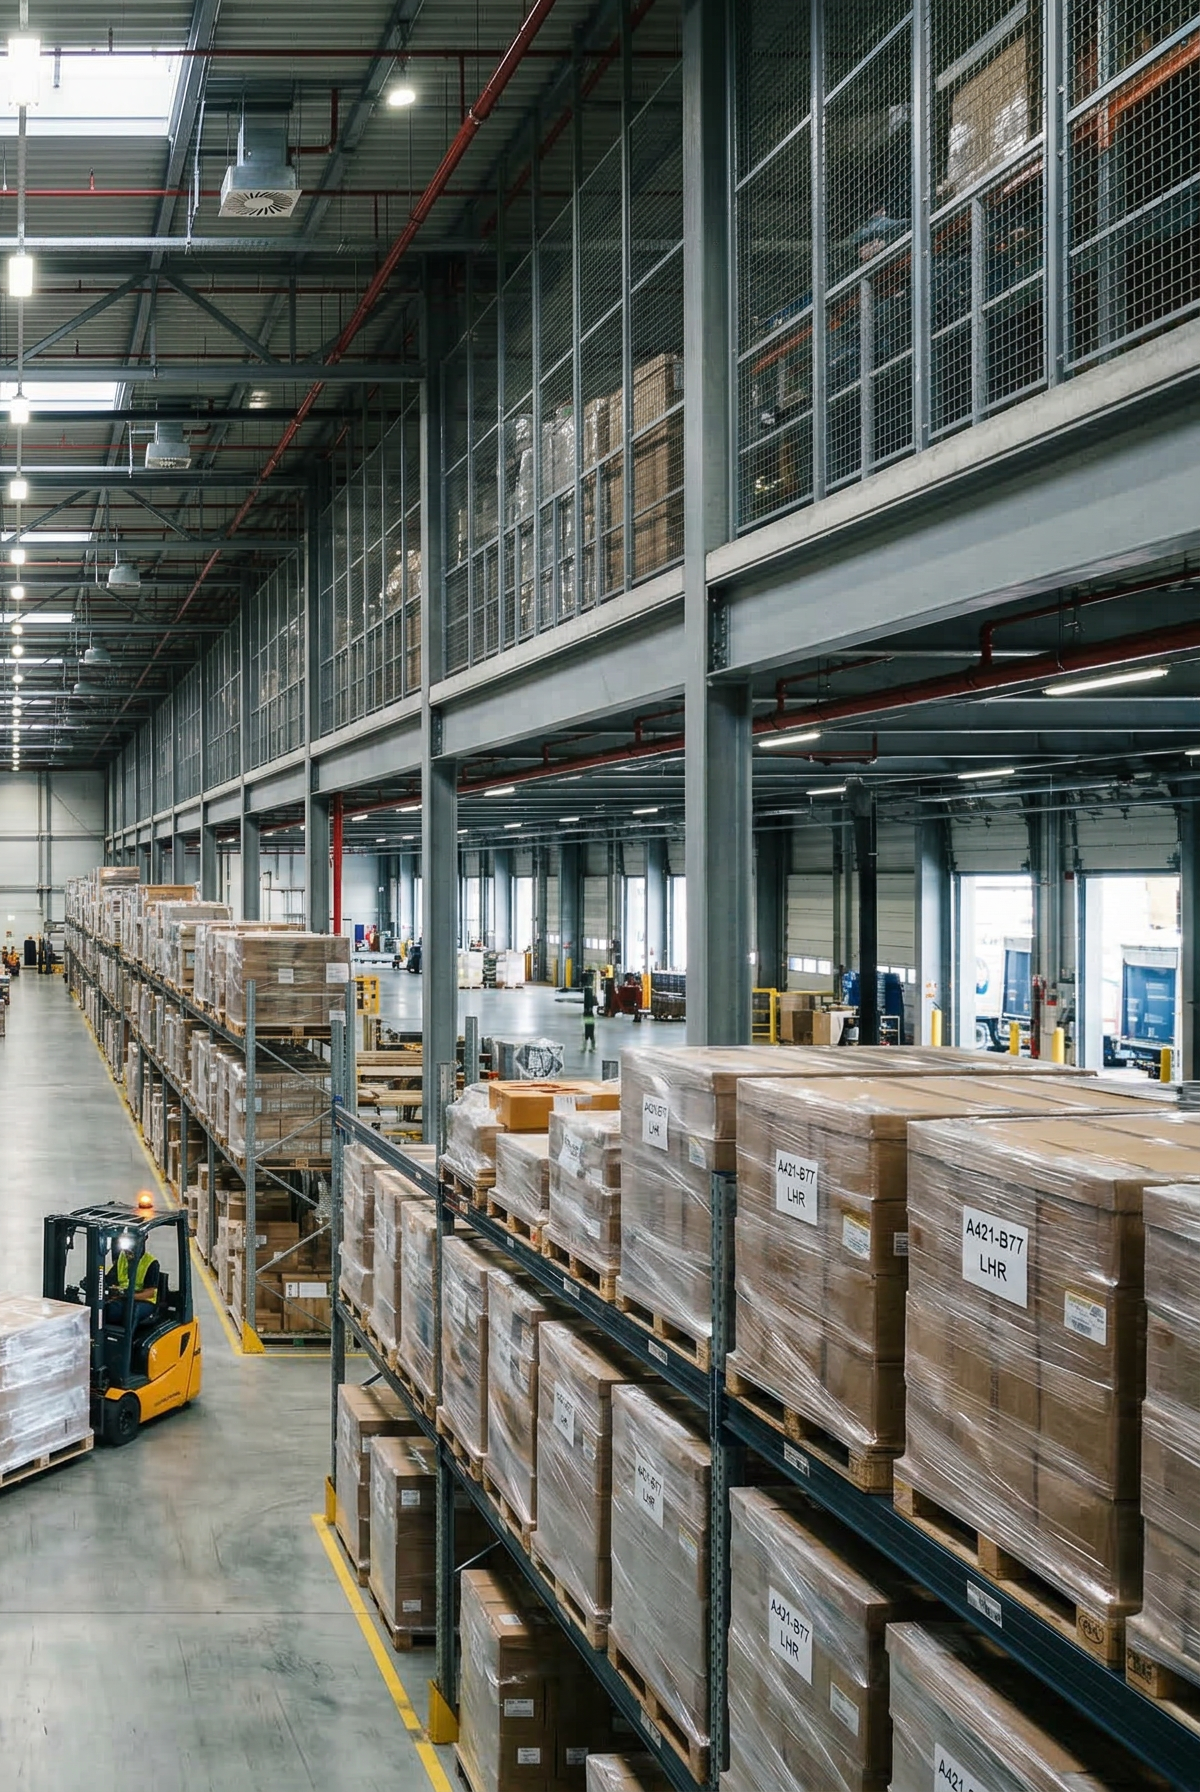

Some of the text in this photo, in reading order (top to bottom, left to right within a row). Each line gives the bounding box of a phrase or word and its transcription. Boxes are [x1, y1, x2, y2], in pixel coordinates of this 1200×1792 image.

[787, 1186, 806, 1208] LHR
[965, 1218, 1024, 1255] A421-B77
[979, 1254, 1007, 1283] LHR
[780, 1630, 800, 1662] LHR
